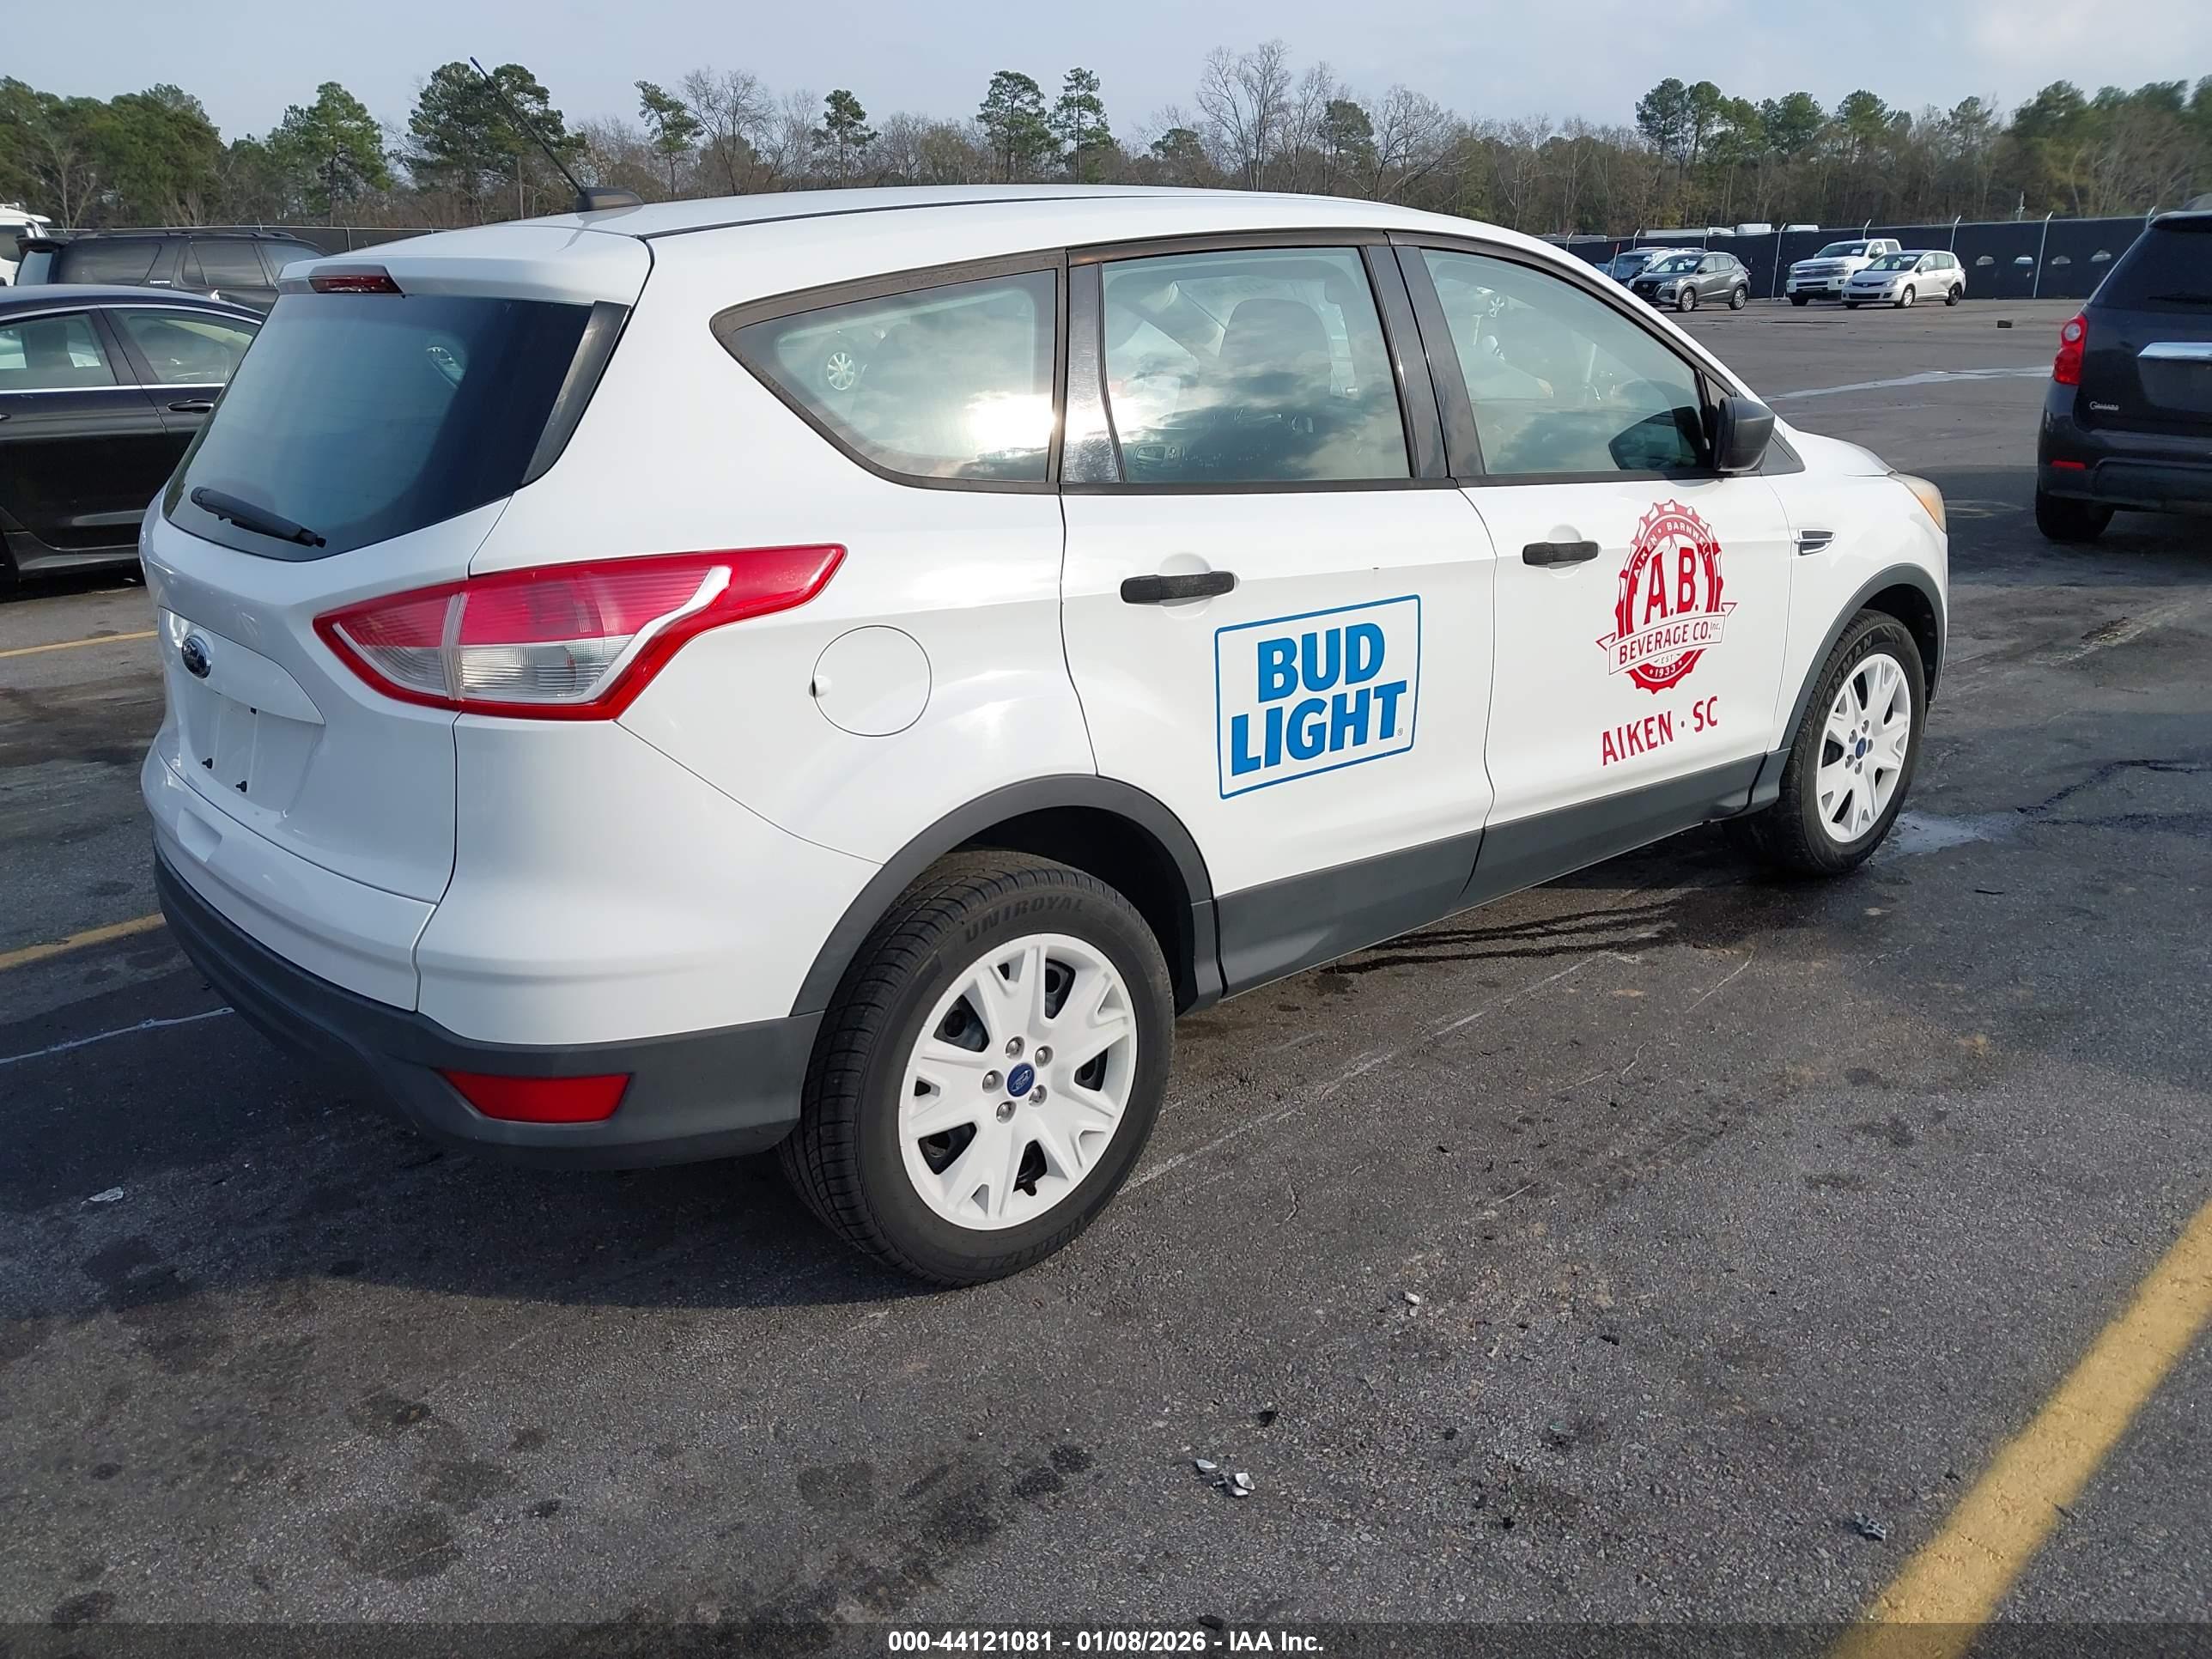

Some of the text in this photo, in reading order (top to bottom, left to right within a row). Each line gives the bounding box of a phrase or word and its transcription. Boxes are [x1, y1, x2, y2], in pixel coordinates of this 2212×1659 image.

[1633, 534, 1657, 579] AIKEN
[1666, 521, 1709, 562] BARNWELL
[1258, 623, 1385, 703] BUD
[1620, 624, 1689, 665] BEVERAGE
[1692, 621, 1711, 641] CO.
[1602, 710, 1674, 766] AIKEN
[1692, 696, 1717, 732] SC
[965, 896, 1083, 944] UNIROYAL
